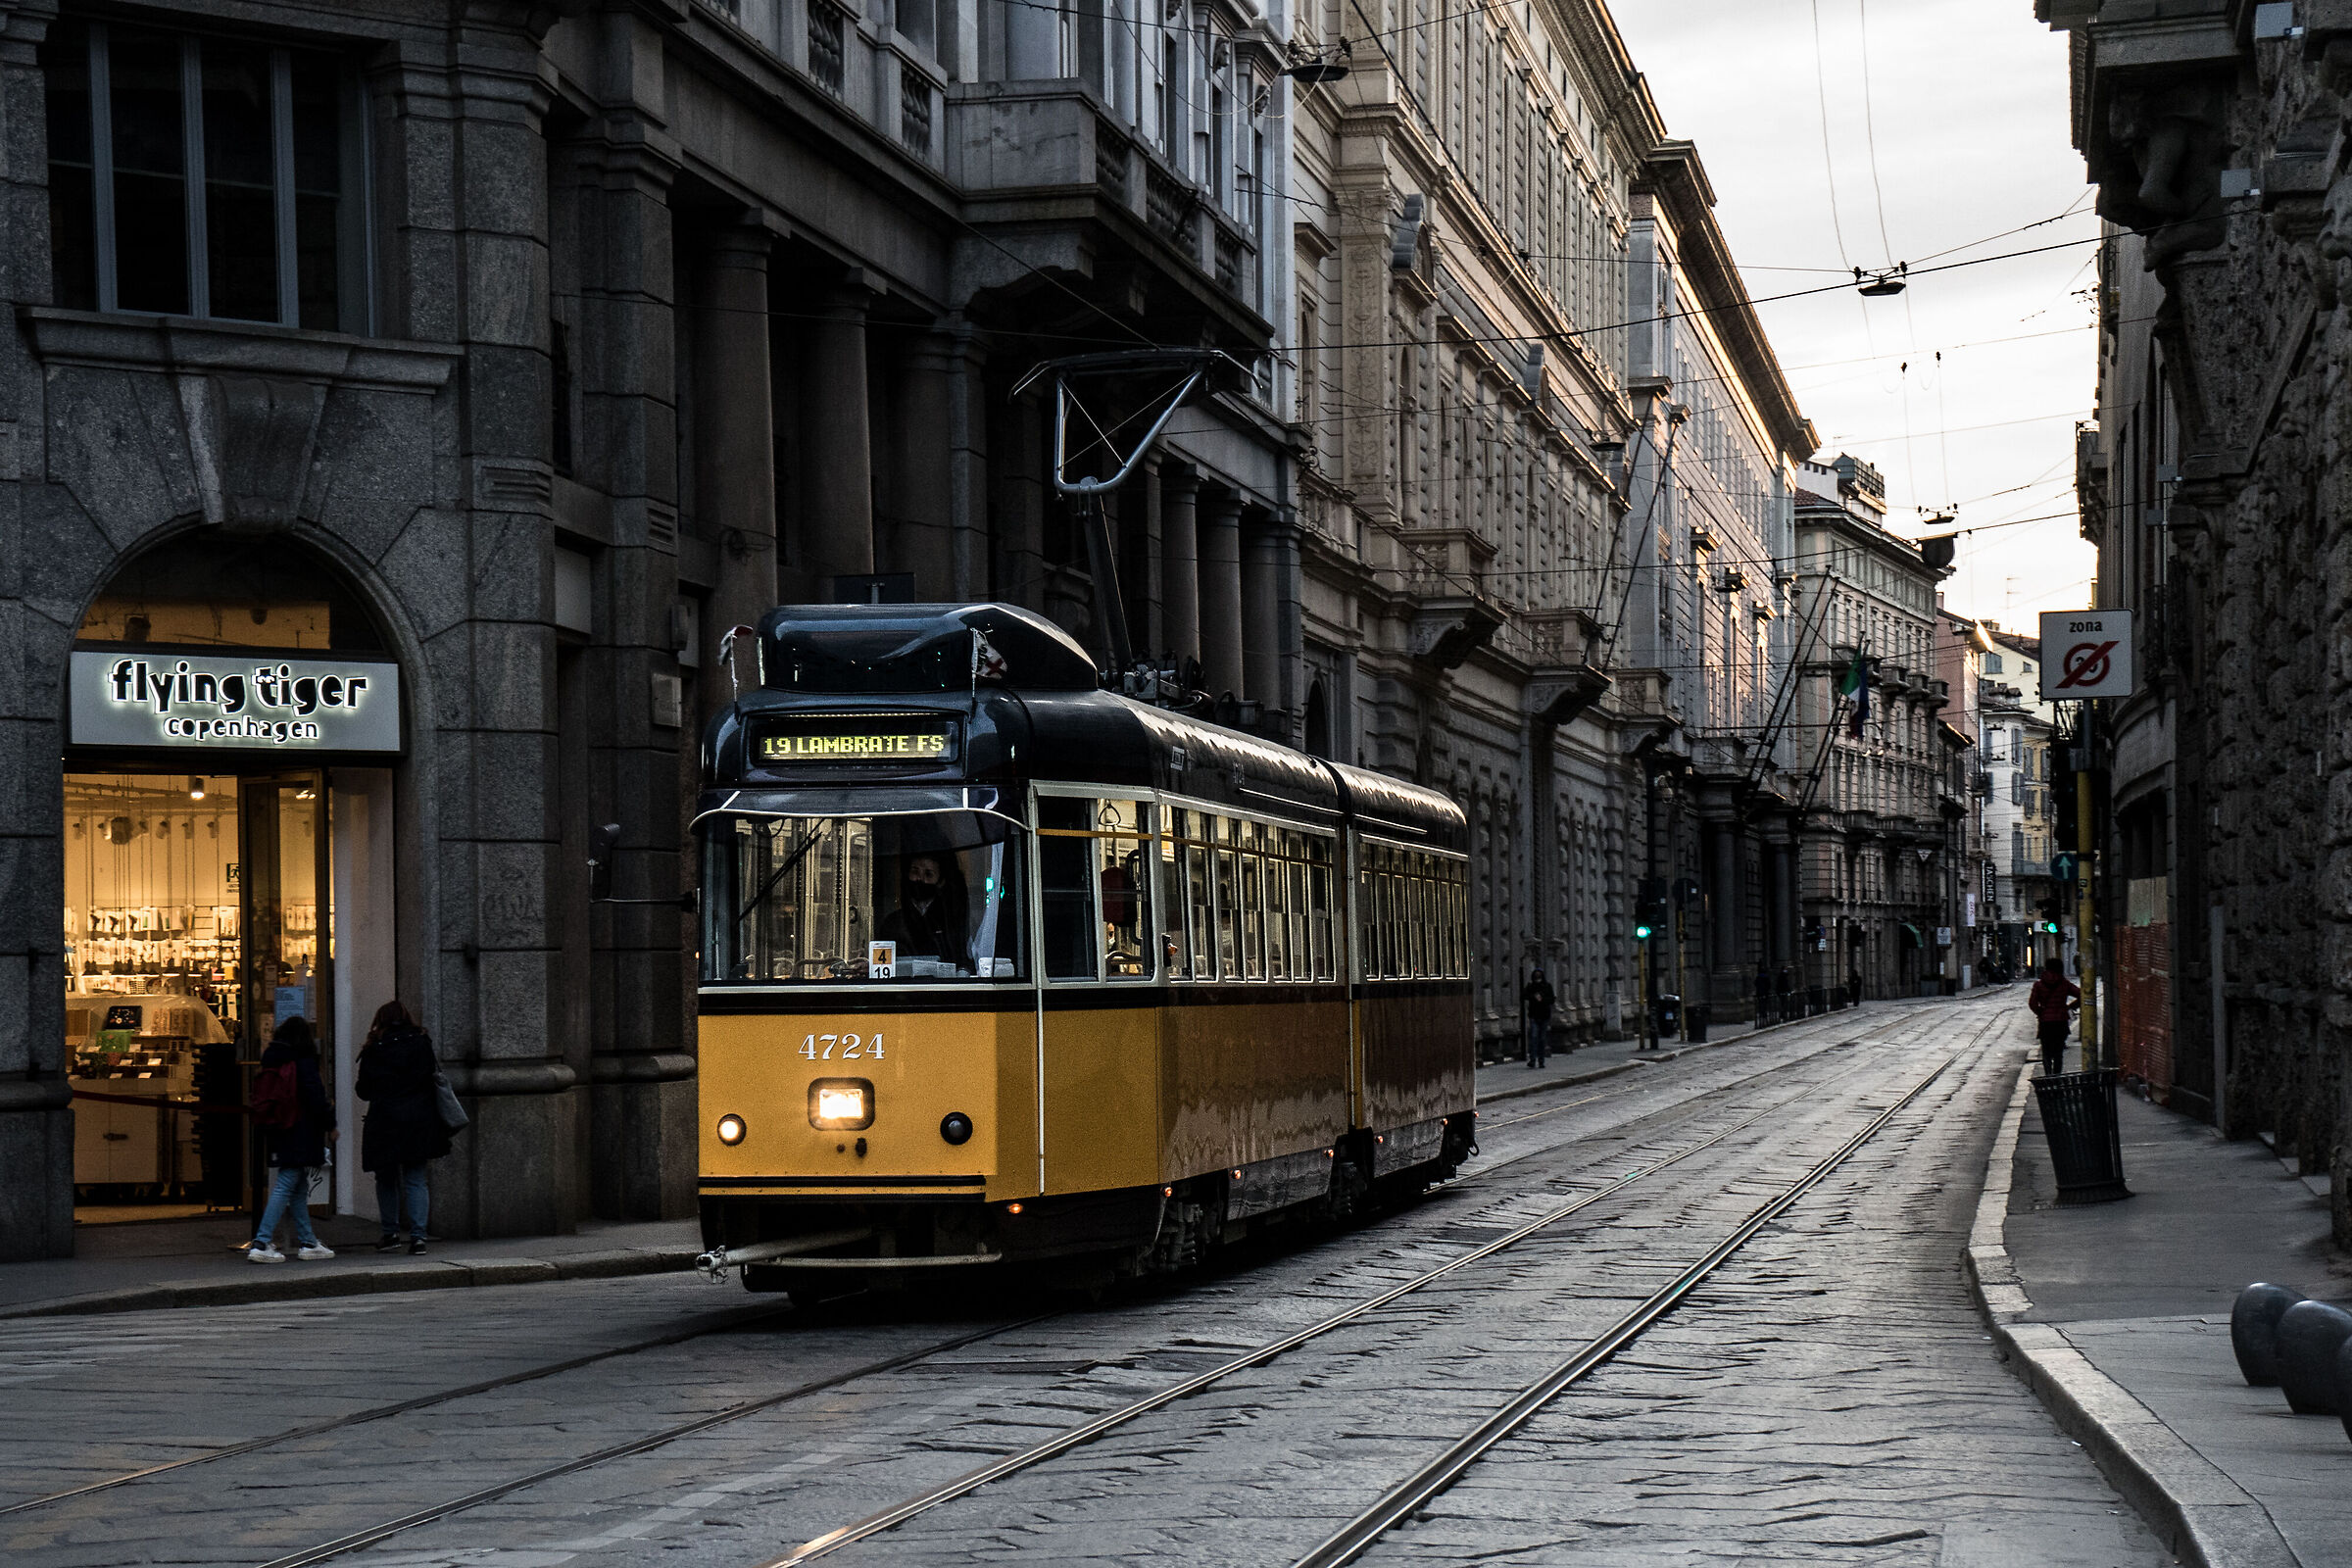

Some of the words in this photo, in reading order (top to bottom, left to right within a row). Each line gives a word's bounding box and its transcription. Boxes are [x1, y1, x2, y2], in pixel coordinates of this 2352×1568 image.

[2069, 620, 2103, 633] zona
[109, 659, 246, 714] flying
[251, 662, 368, 716] tiger
[163, 714, 319, 745] copenhagen
[764, 737, 791, 755] 19
[796, 735, 909, 754] LAMBRATE
[917, 735, 945, 753] FS
[878, 950, 886, 964] 4
[874, 967, 890, 978] 19
[798, 1033, 885, 1060] 4724
